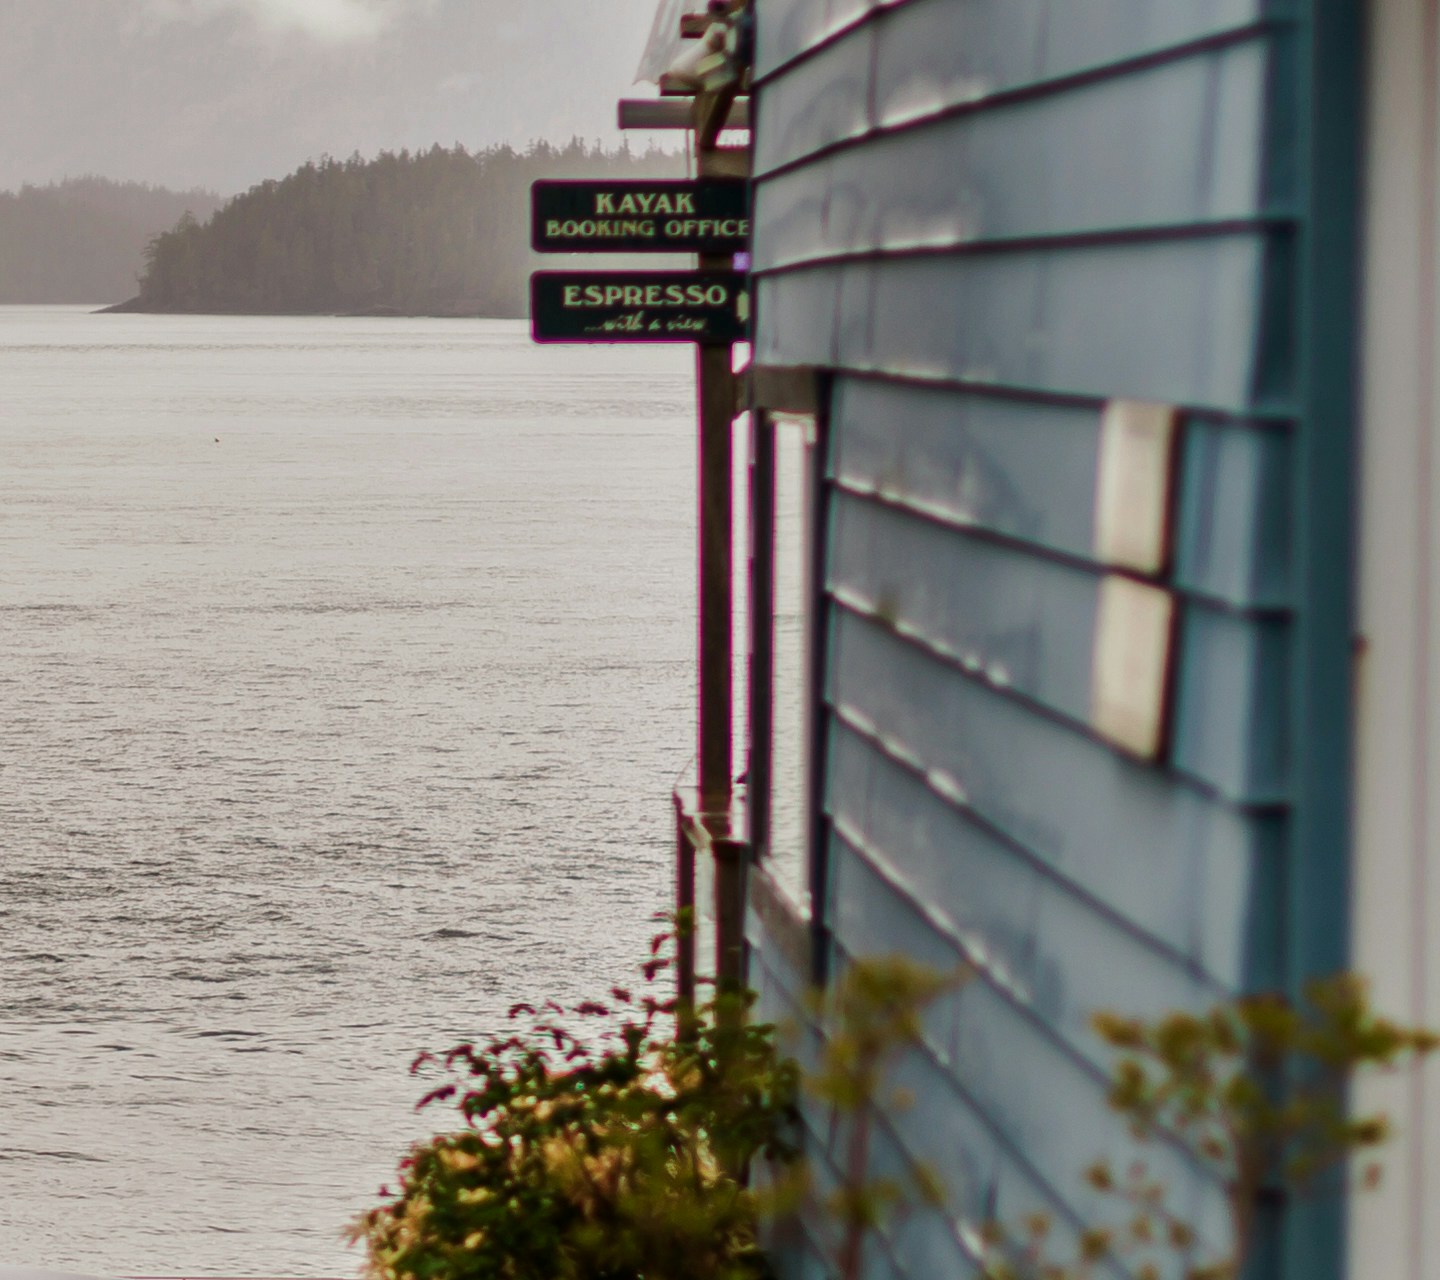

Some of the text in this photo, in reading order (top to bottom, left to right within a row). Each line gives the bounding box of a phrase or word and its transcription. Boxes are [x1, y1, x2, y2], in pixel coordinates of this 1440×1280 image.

[594, 193, 696, 214] KAYAK
[545, 219, 750, 237] BOOKING OFFICE
[562, 285, 728, 307] ESPRESSO
